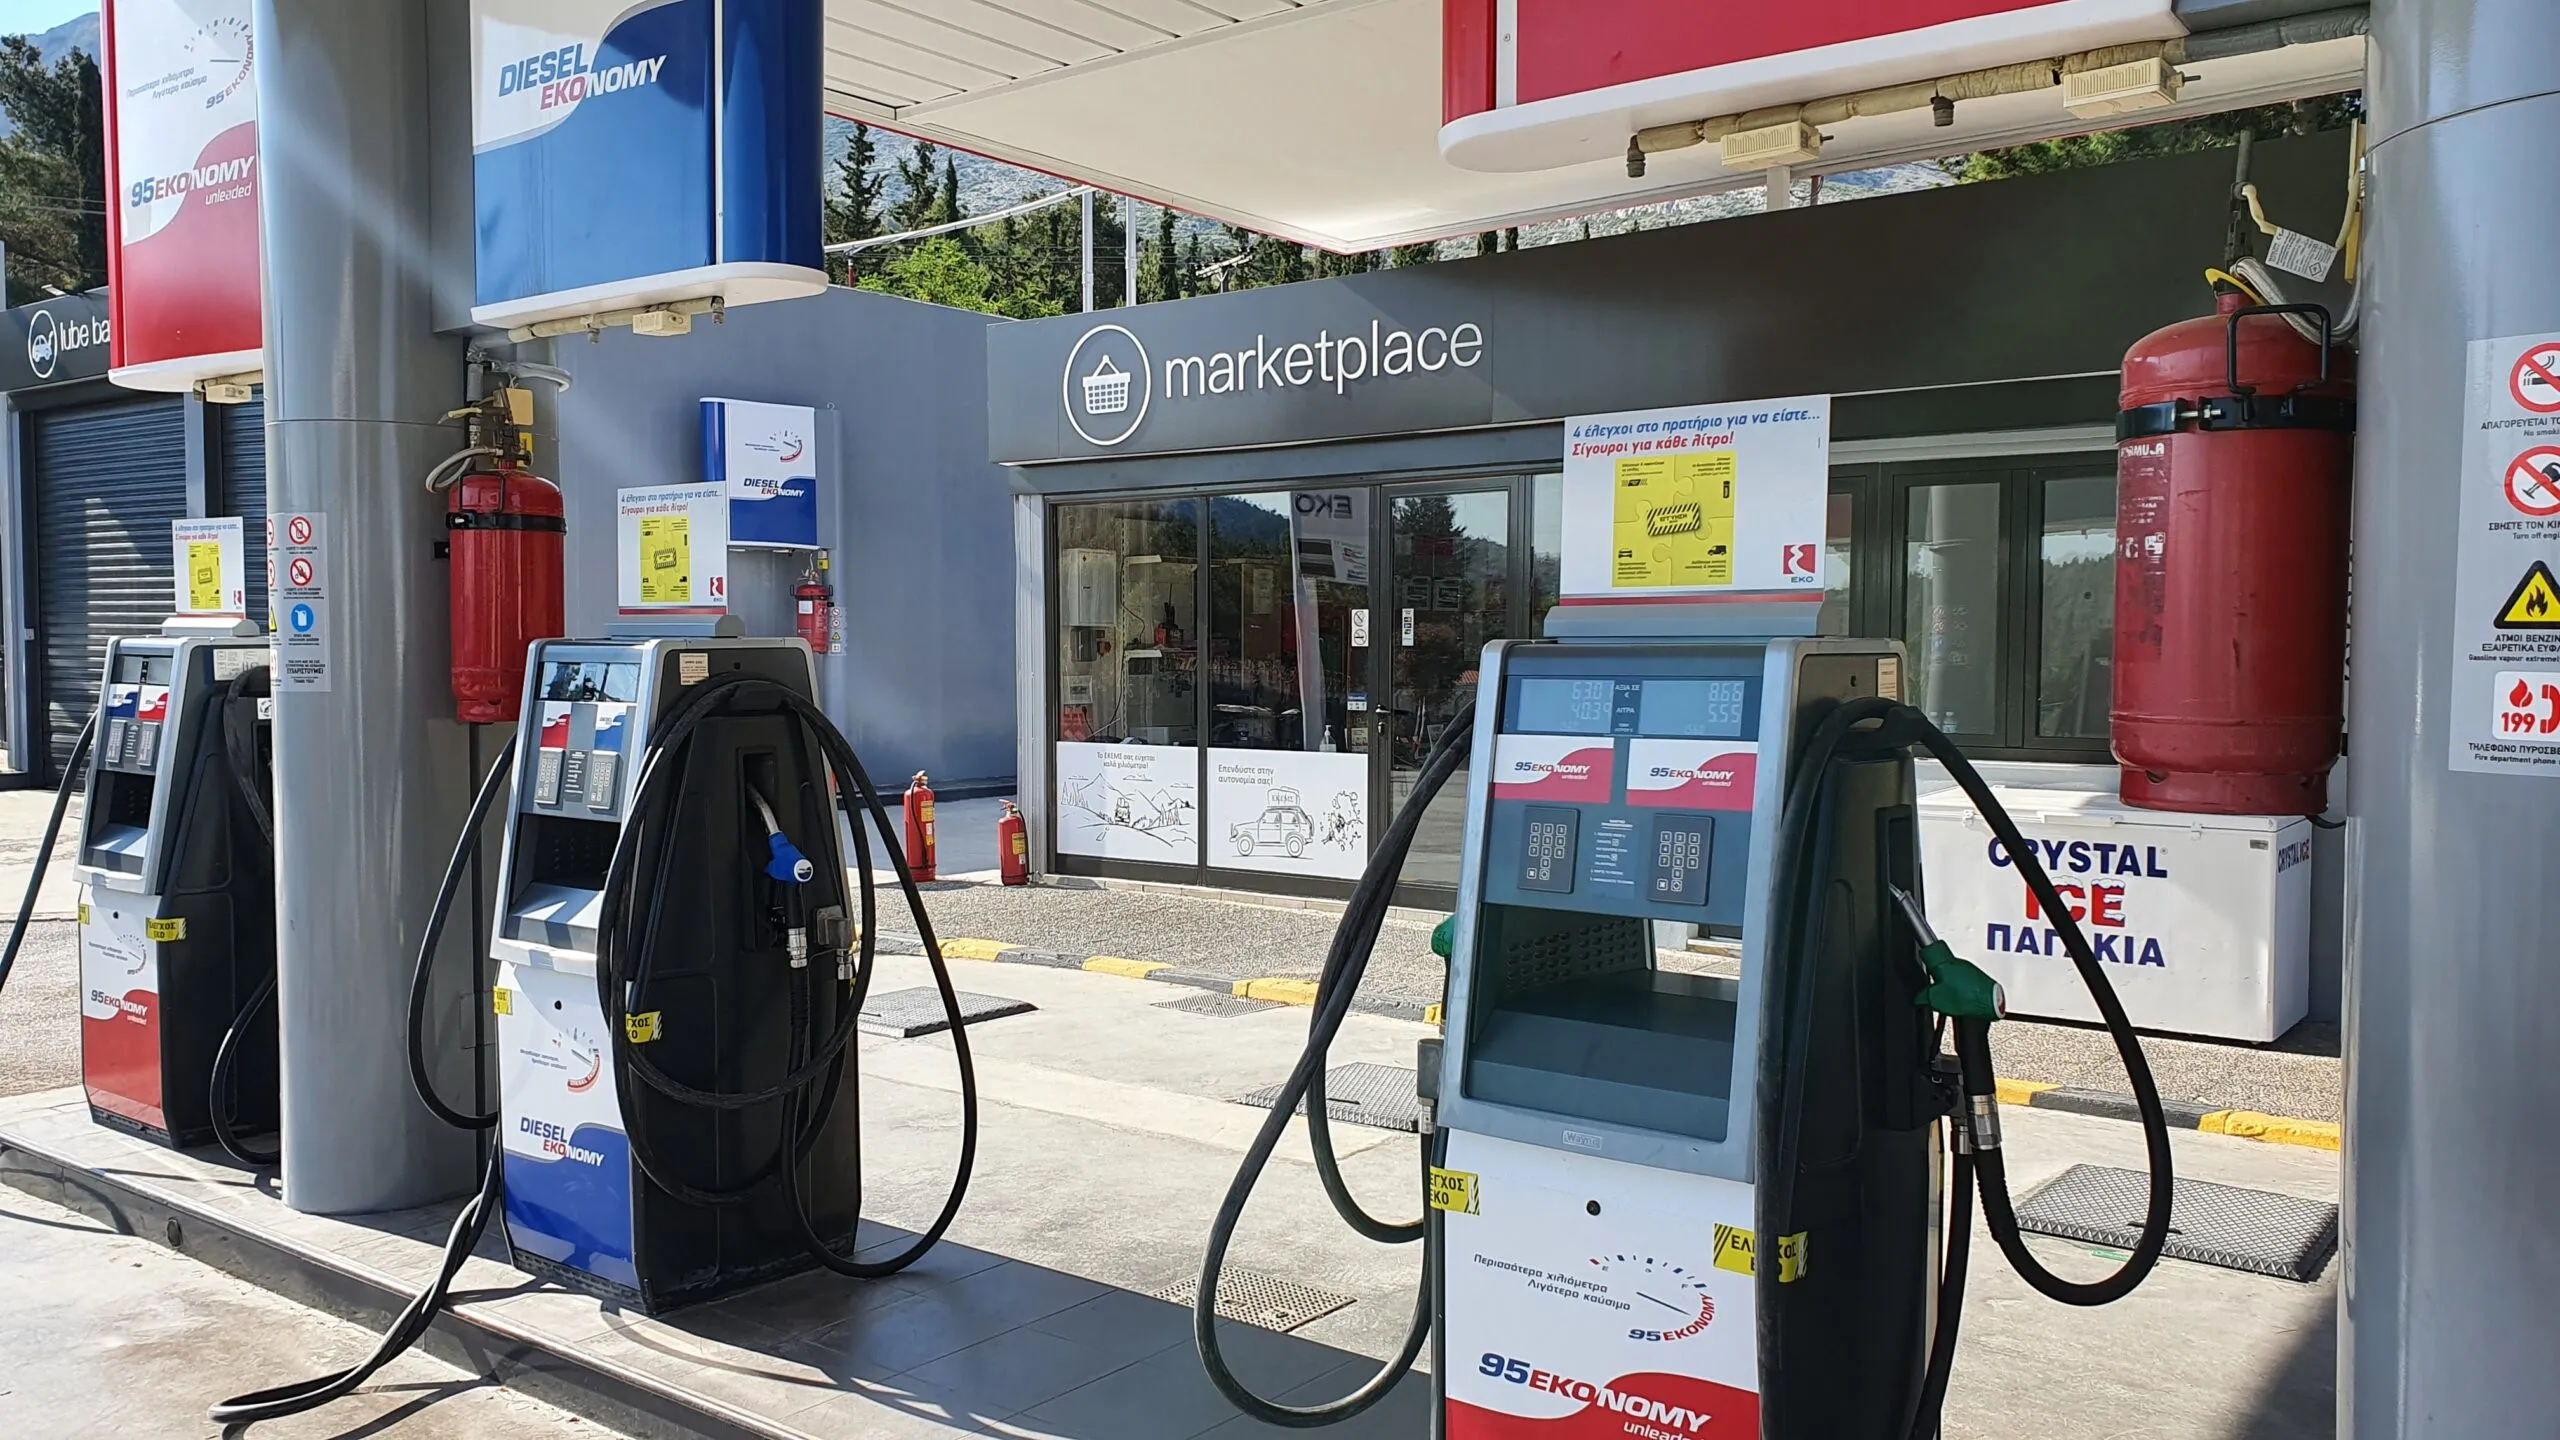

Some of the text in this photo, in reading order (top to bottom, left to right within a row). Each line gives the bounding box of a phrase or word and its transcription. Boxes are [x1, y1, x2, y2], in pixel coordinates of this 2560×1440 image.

[498, 43, 589, 98] DIESEL
[540, 55, 667, 110] EKONOMY
[131, 155, 255, 208] 95EKONOMY
[205, 181, 252, 206] unleaded
[60, 315, 110, 351] lube ba
[1165, 319, 1483, 398] marketplace
[1572, 425, 1581, 439] 4
[1584, 423, 1633, 440] έλεγχοι
[1637, 422, 1658, 433] στο
[1662, 416, 1722, 434] πρατήριο
[1726, 415, 1748, 429] για
[1751, 414, 1768, 424] να
[2481, 417, 2548, 430] ΑΠΑΓΟΡΕΥΕΤΑΙ
[2536, 427, 2560, 436] smoki
[1571, 430, 1735, 458] Σίγουροι για κάθε λίτρο!
[743, 478, 781, 489] DIESEL
[2489, 521, 2523, 530] ΣΒΗΣΤΕ
[2525, 521, 2545, 529] ΤΟΝ
[2543, 532, 2560, 540] engi
[2482, 643, 2535, 652] ΕΞΑΙΡΕΤΙΚΑ
[2495, 633, 2560, 642] ΑΤΜΟΙ ΒΕΝΖΙΝ
[2501, 712, 2536, 733] 199
[2468, 742, 2560, 755] ΤΗΛΕΦΩΝΟ ΠΥΡΟΣΒΕ
[1218, 764, 1274, 776] Επενδύστε στην
[1514, 762, 1591, 774] 95EKONOMY
[1649, 767, 1736, 780] 95EKONOMY
[1218, 775, 1256, 785] αυτονομία
[1987, 923, 2166, 968] ΠΑΓΚΙΑ
[91, 989, 148, 1016] 95EKONOMY
[520, 1116, 568, 1143] DIESEL
[543, 1139, 604, 1167] EKONOMY
[1430, 1172, 1465, 1192] ΕΓΧΟΣ
[1473, 1253, 1608, 1293] Περισσότερα χιλιόμετρα
[1628, 1292, 1715, 1342] 95EKONOMY
[1479, 1352, 1712, 1433] 95EKONOMY
[1623, 1421, 1706, 1440] unlead
